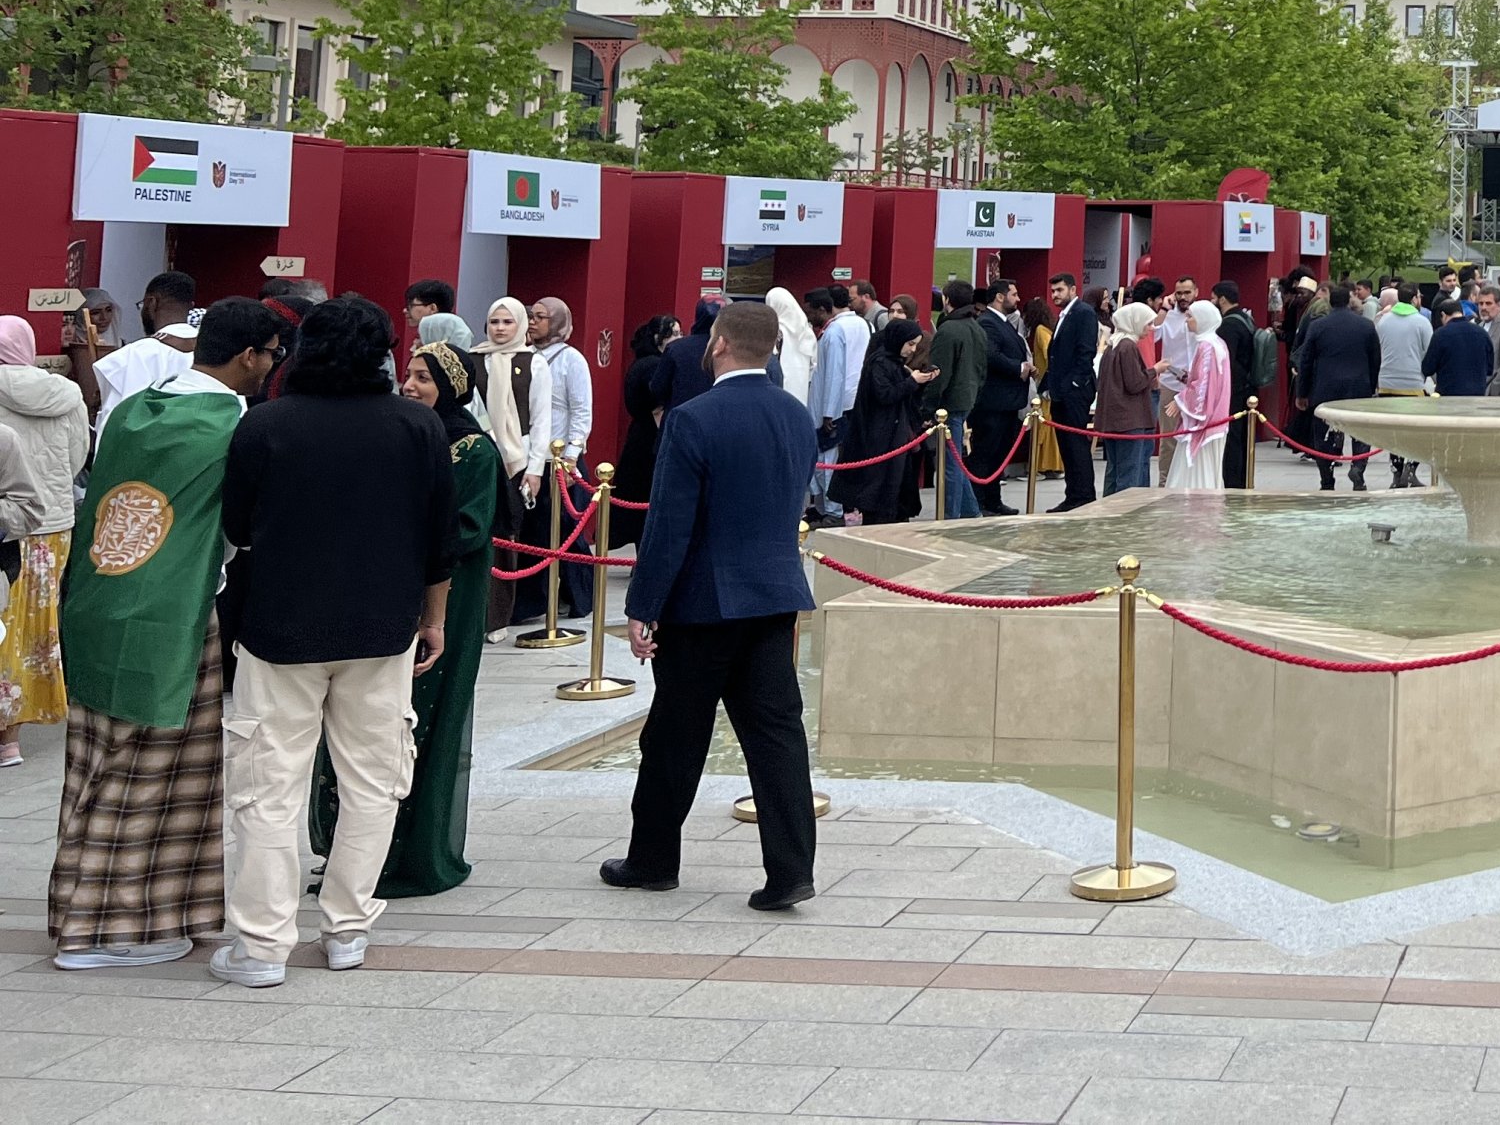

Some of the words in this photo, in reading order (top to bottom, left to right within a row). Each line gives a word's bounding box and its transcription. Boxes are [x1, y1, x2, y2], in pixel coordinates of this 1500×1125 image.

[134, 187, 192, 202] PALESTINE
[500, 209, 545, 222] BANGLADESH
[762, 222, 780, 232] SYRIA
[966, 229, 995, 238] PAKISTAN
